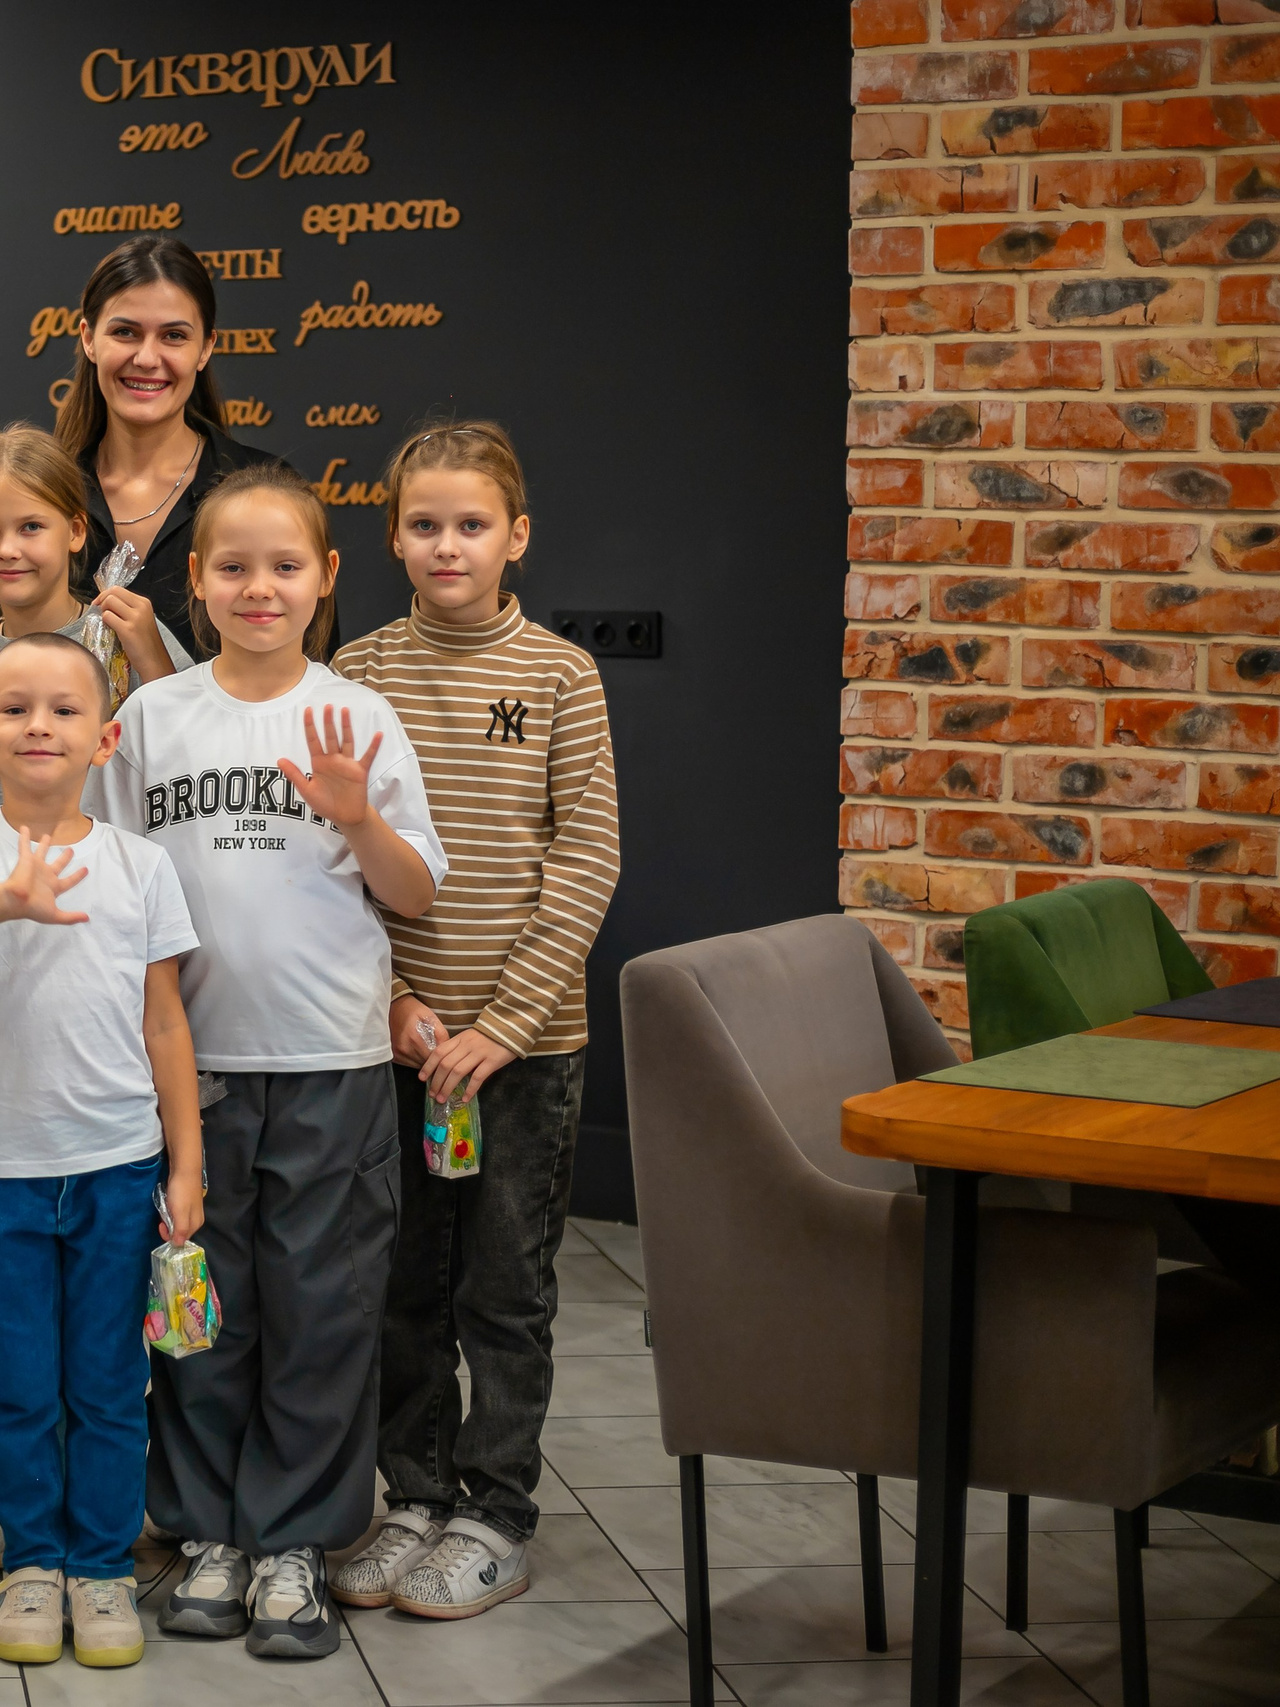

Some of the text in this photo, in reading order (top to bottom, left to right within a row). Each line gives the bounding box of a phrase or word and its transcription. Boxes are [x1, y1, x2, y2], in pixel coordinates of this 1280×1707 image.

[81, 41, 397, 107] Сикварули
[119, 116, 370, 179] это Любовь
[54, 202, 182, 234] счастье
[302, 199, 461, 245] верность
[294, 280, 444, 347] радость
[305, 402, 381, 427] смех
[485, 696, 529, 744] NY
[145, 766, 343, 835] BROOKL
[213, 837, 287, 851] NEW YORK
[234, 819, 267, 832] 1898
